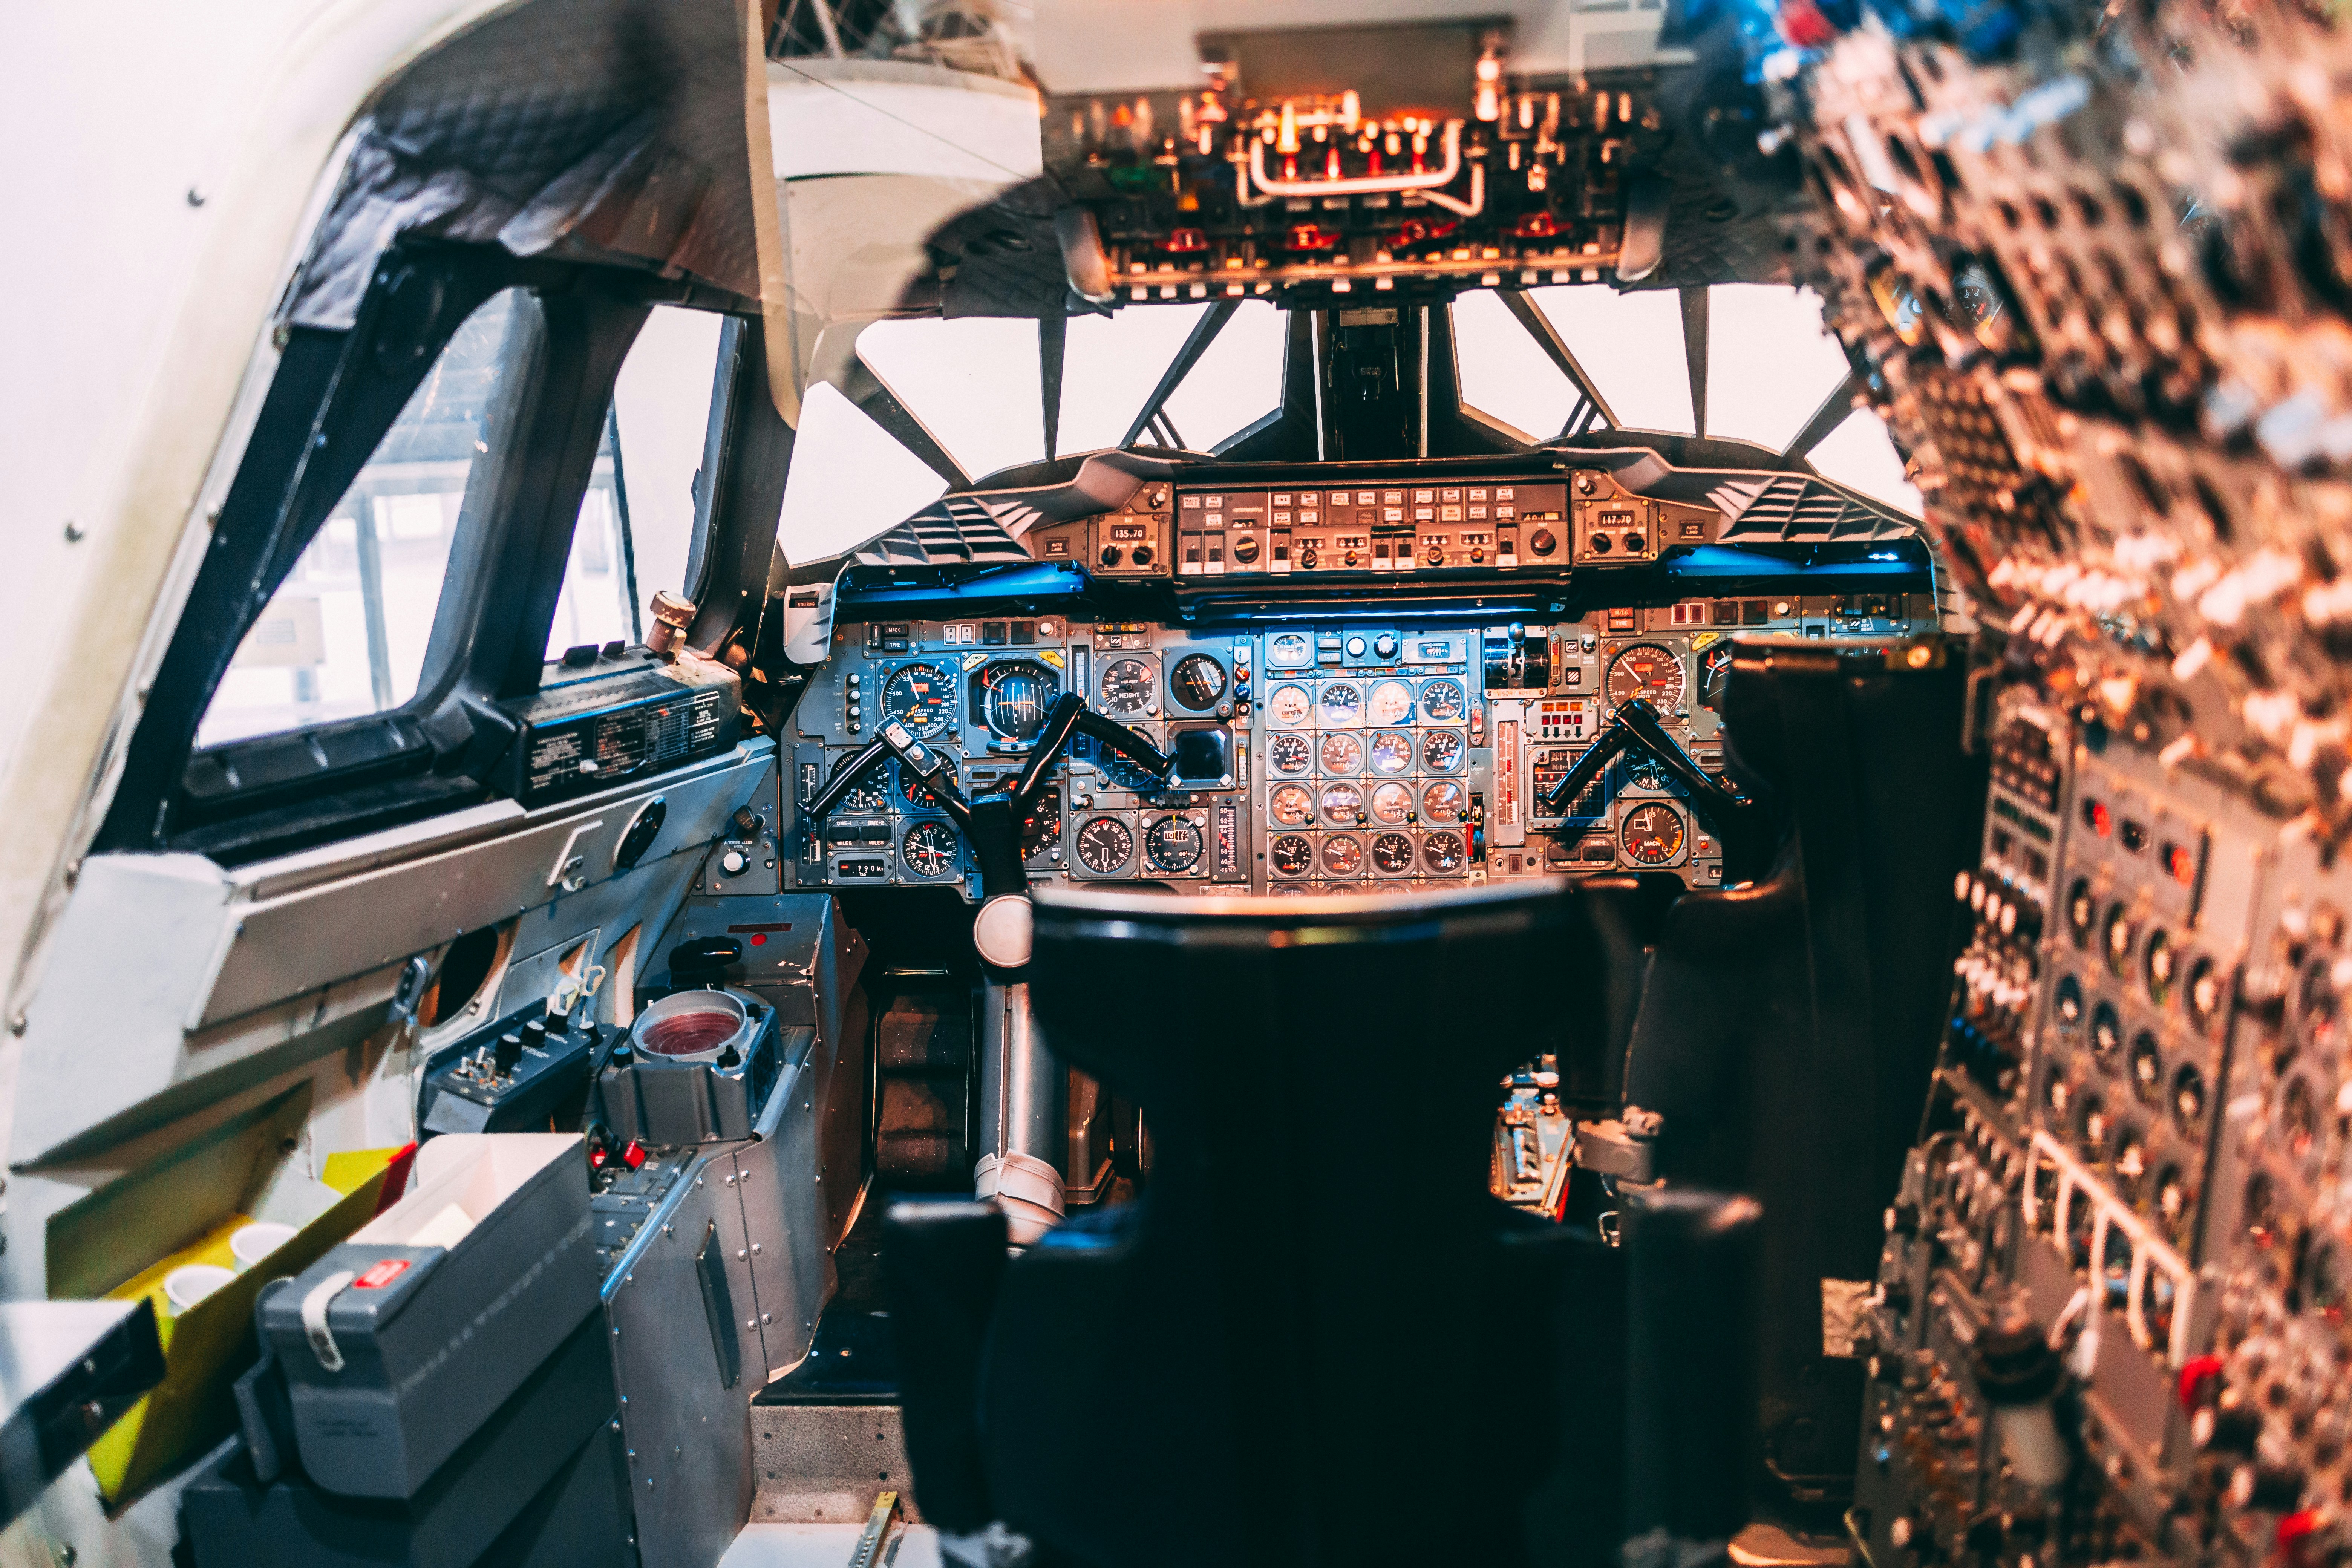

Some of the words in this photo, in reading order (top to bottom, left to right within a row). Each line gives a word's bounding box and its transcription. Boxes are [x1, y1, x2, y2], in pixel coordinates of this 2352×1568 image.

[1602, 515, 1631, 524] 117.70
[1115, 529, 1142, 538] 135.70
[1092, 825, 1101, 834] 24
[1032, 845, 1041, 854] 24
